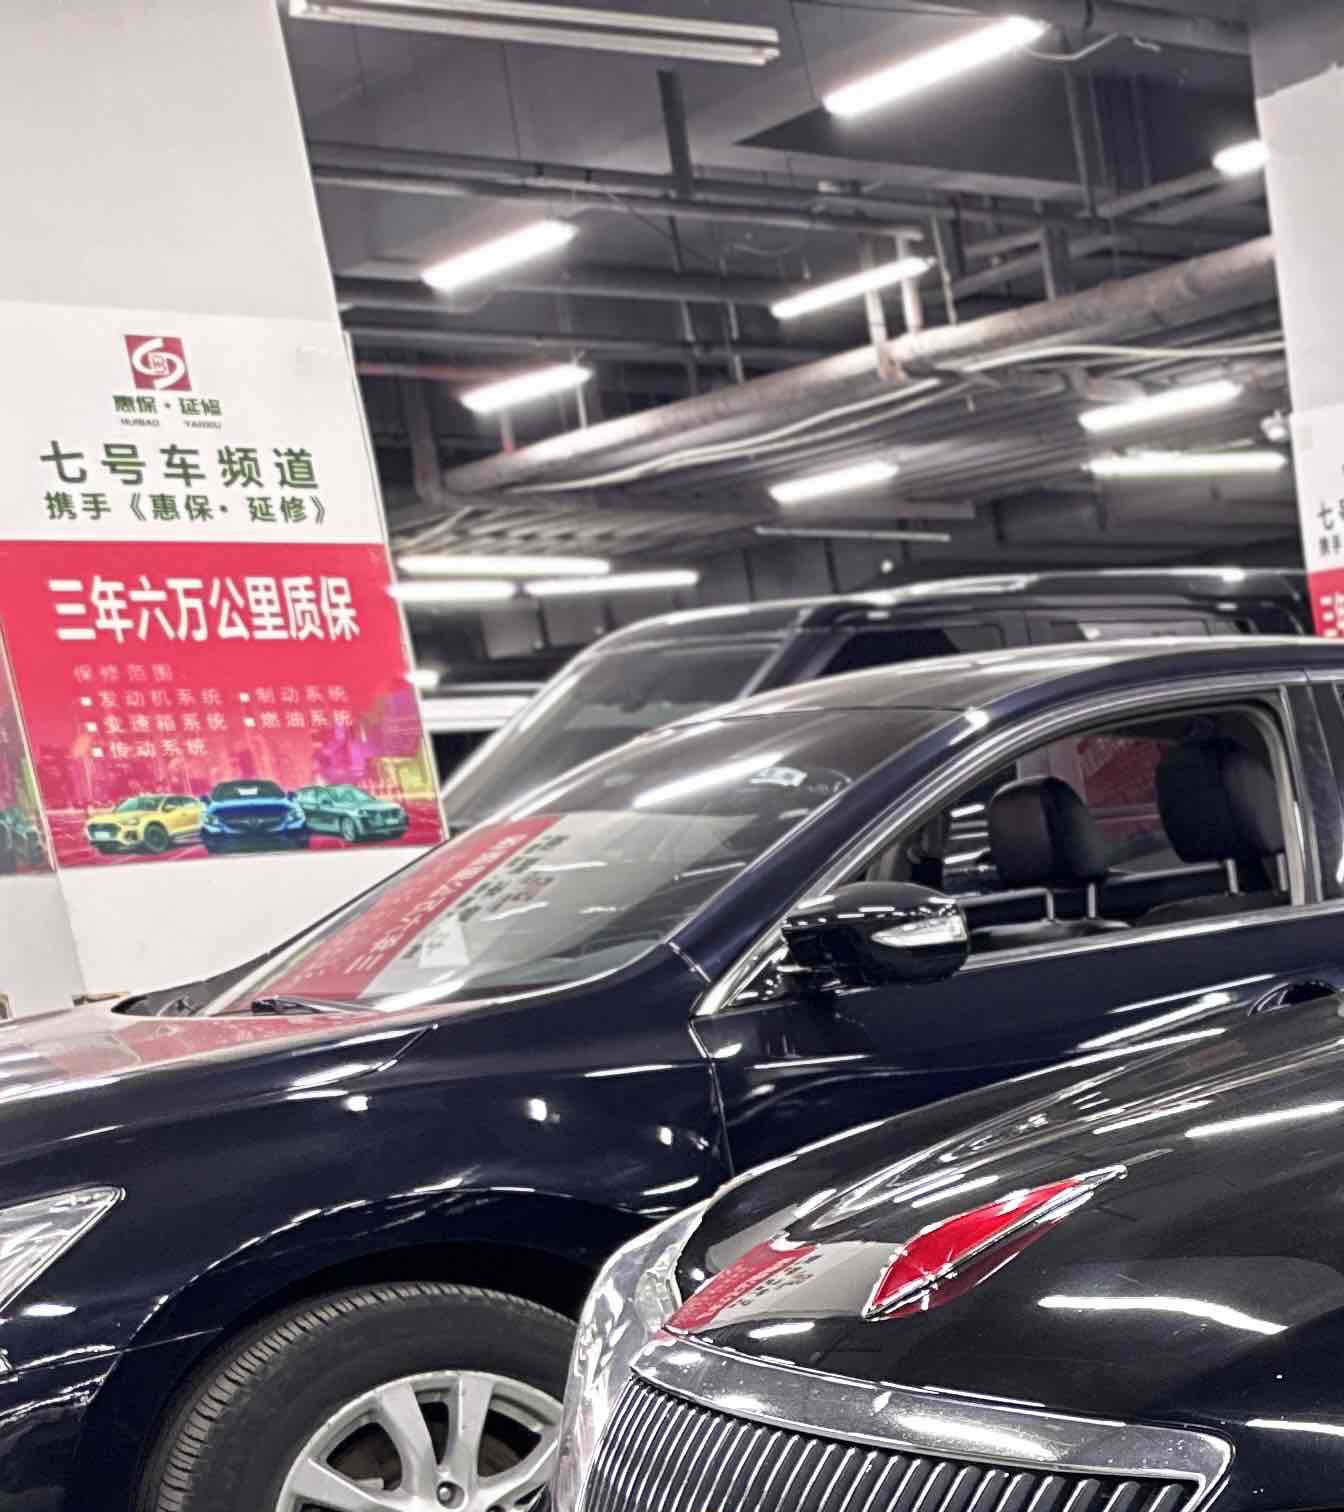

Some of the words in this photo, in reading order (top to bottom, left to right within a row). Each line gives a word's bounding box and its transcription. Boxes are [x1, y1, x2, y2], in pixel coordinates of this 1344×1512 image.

[40, 441, 318, 489] 七号车频道
[48, 575, 361, 644] 三年六万公里质保
